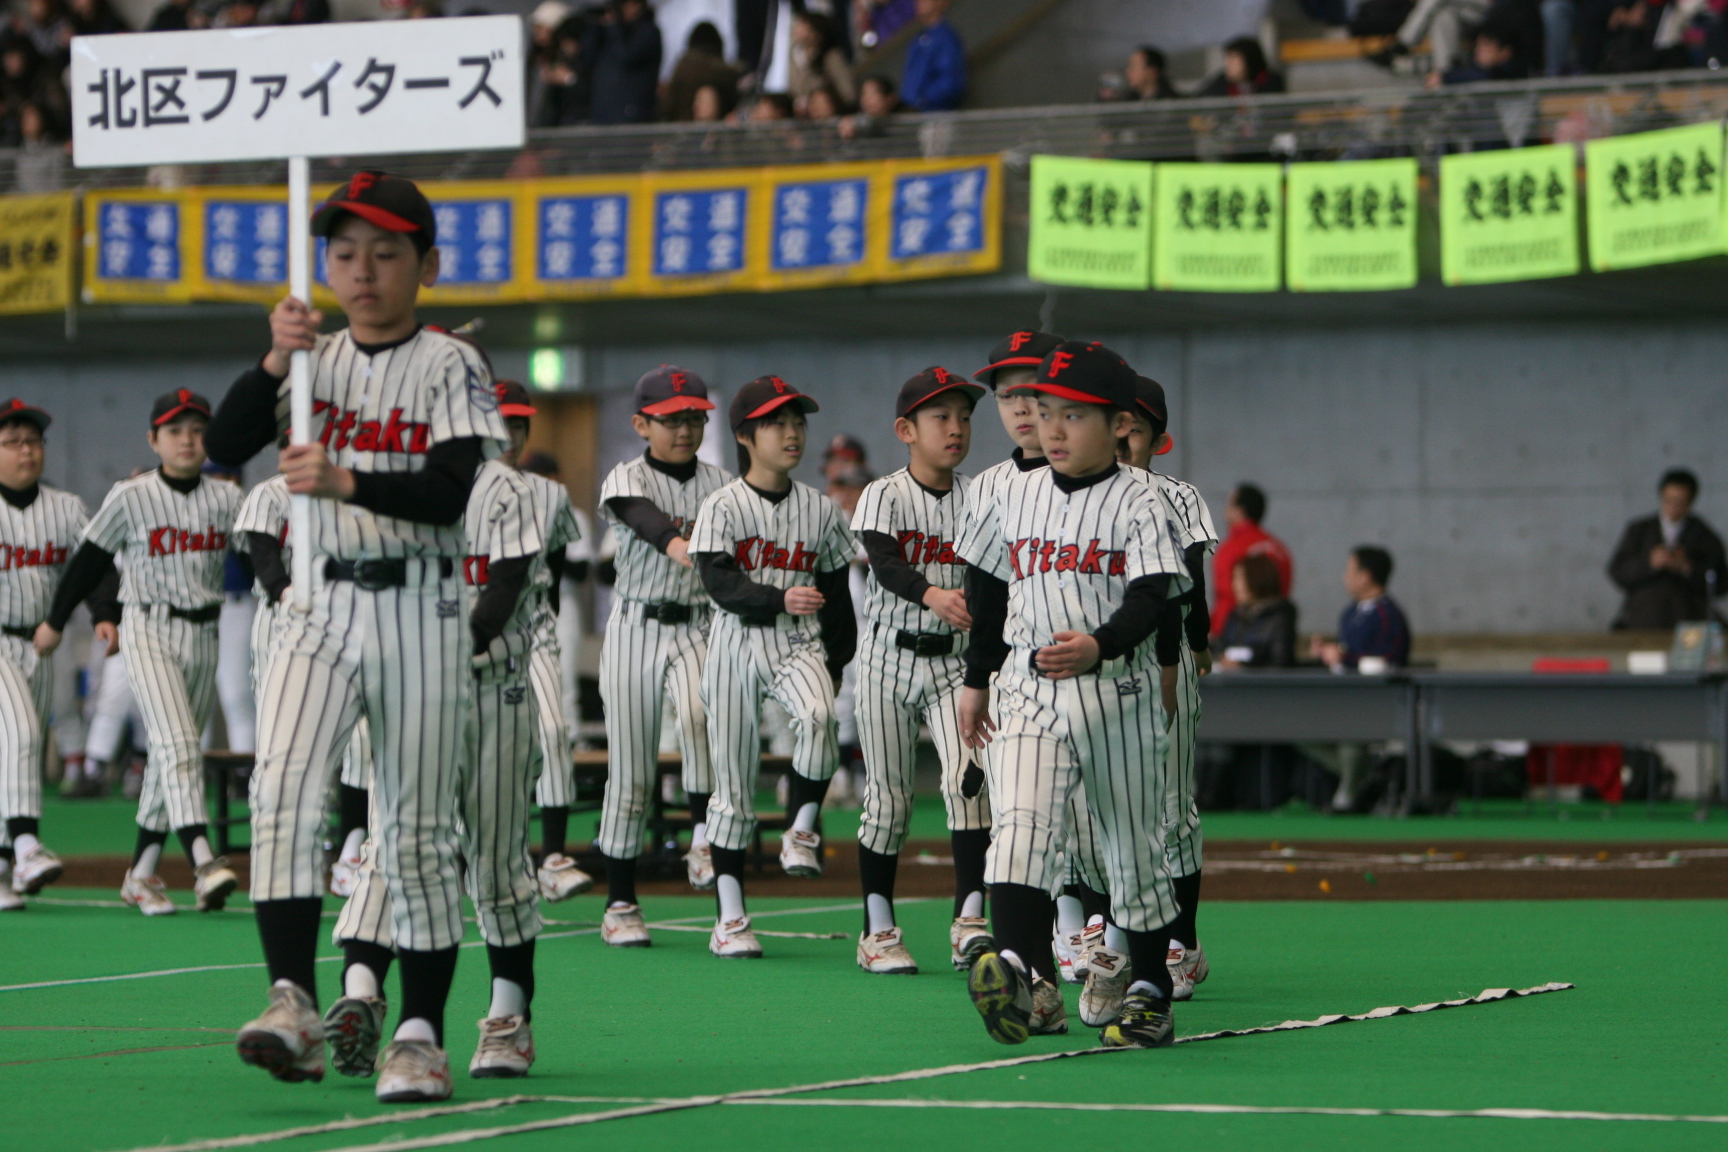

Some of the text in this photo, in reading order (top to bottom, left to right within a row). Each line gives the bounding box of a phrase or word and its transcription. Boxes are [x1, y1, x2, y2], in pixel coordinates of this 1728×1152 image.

[88, 49, 504, 130] 北区ファイターズ
[347, 172, 378, 199] F
[1009, 331, 1033, 352] F
[1047, 351, 1075, 378] F
[670, 373, 688, 393] F
[1006, 537, 1127, 580] Kitaku
